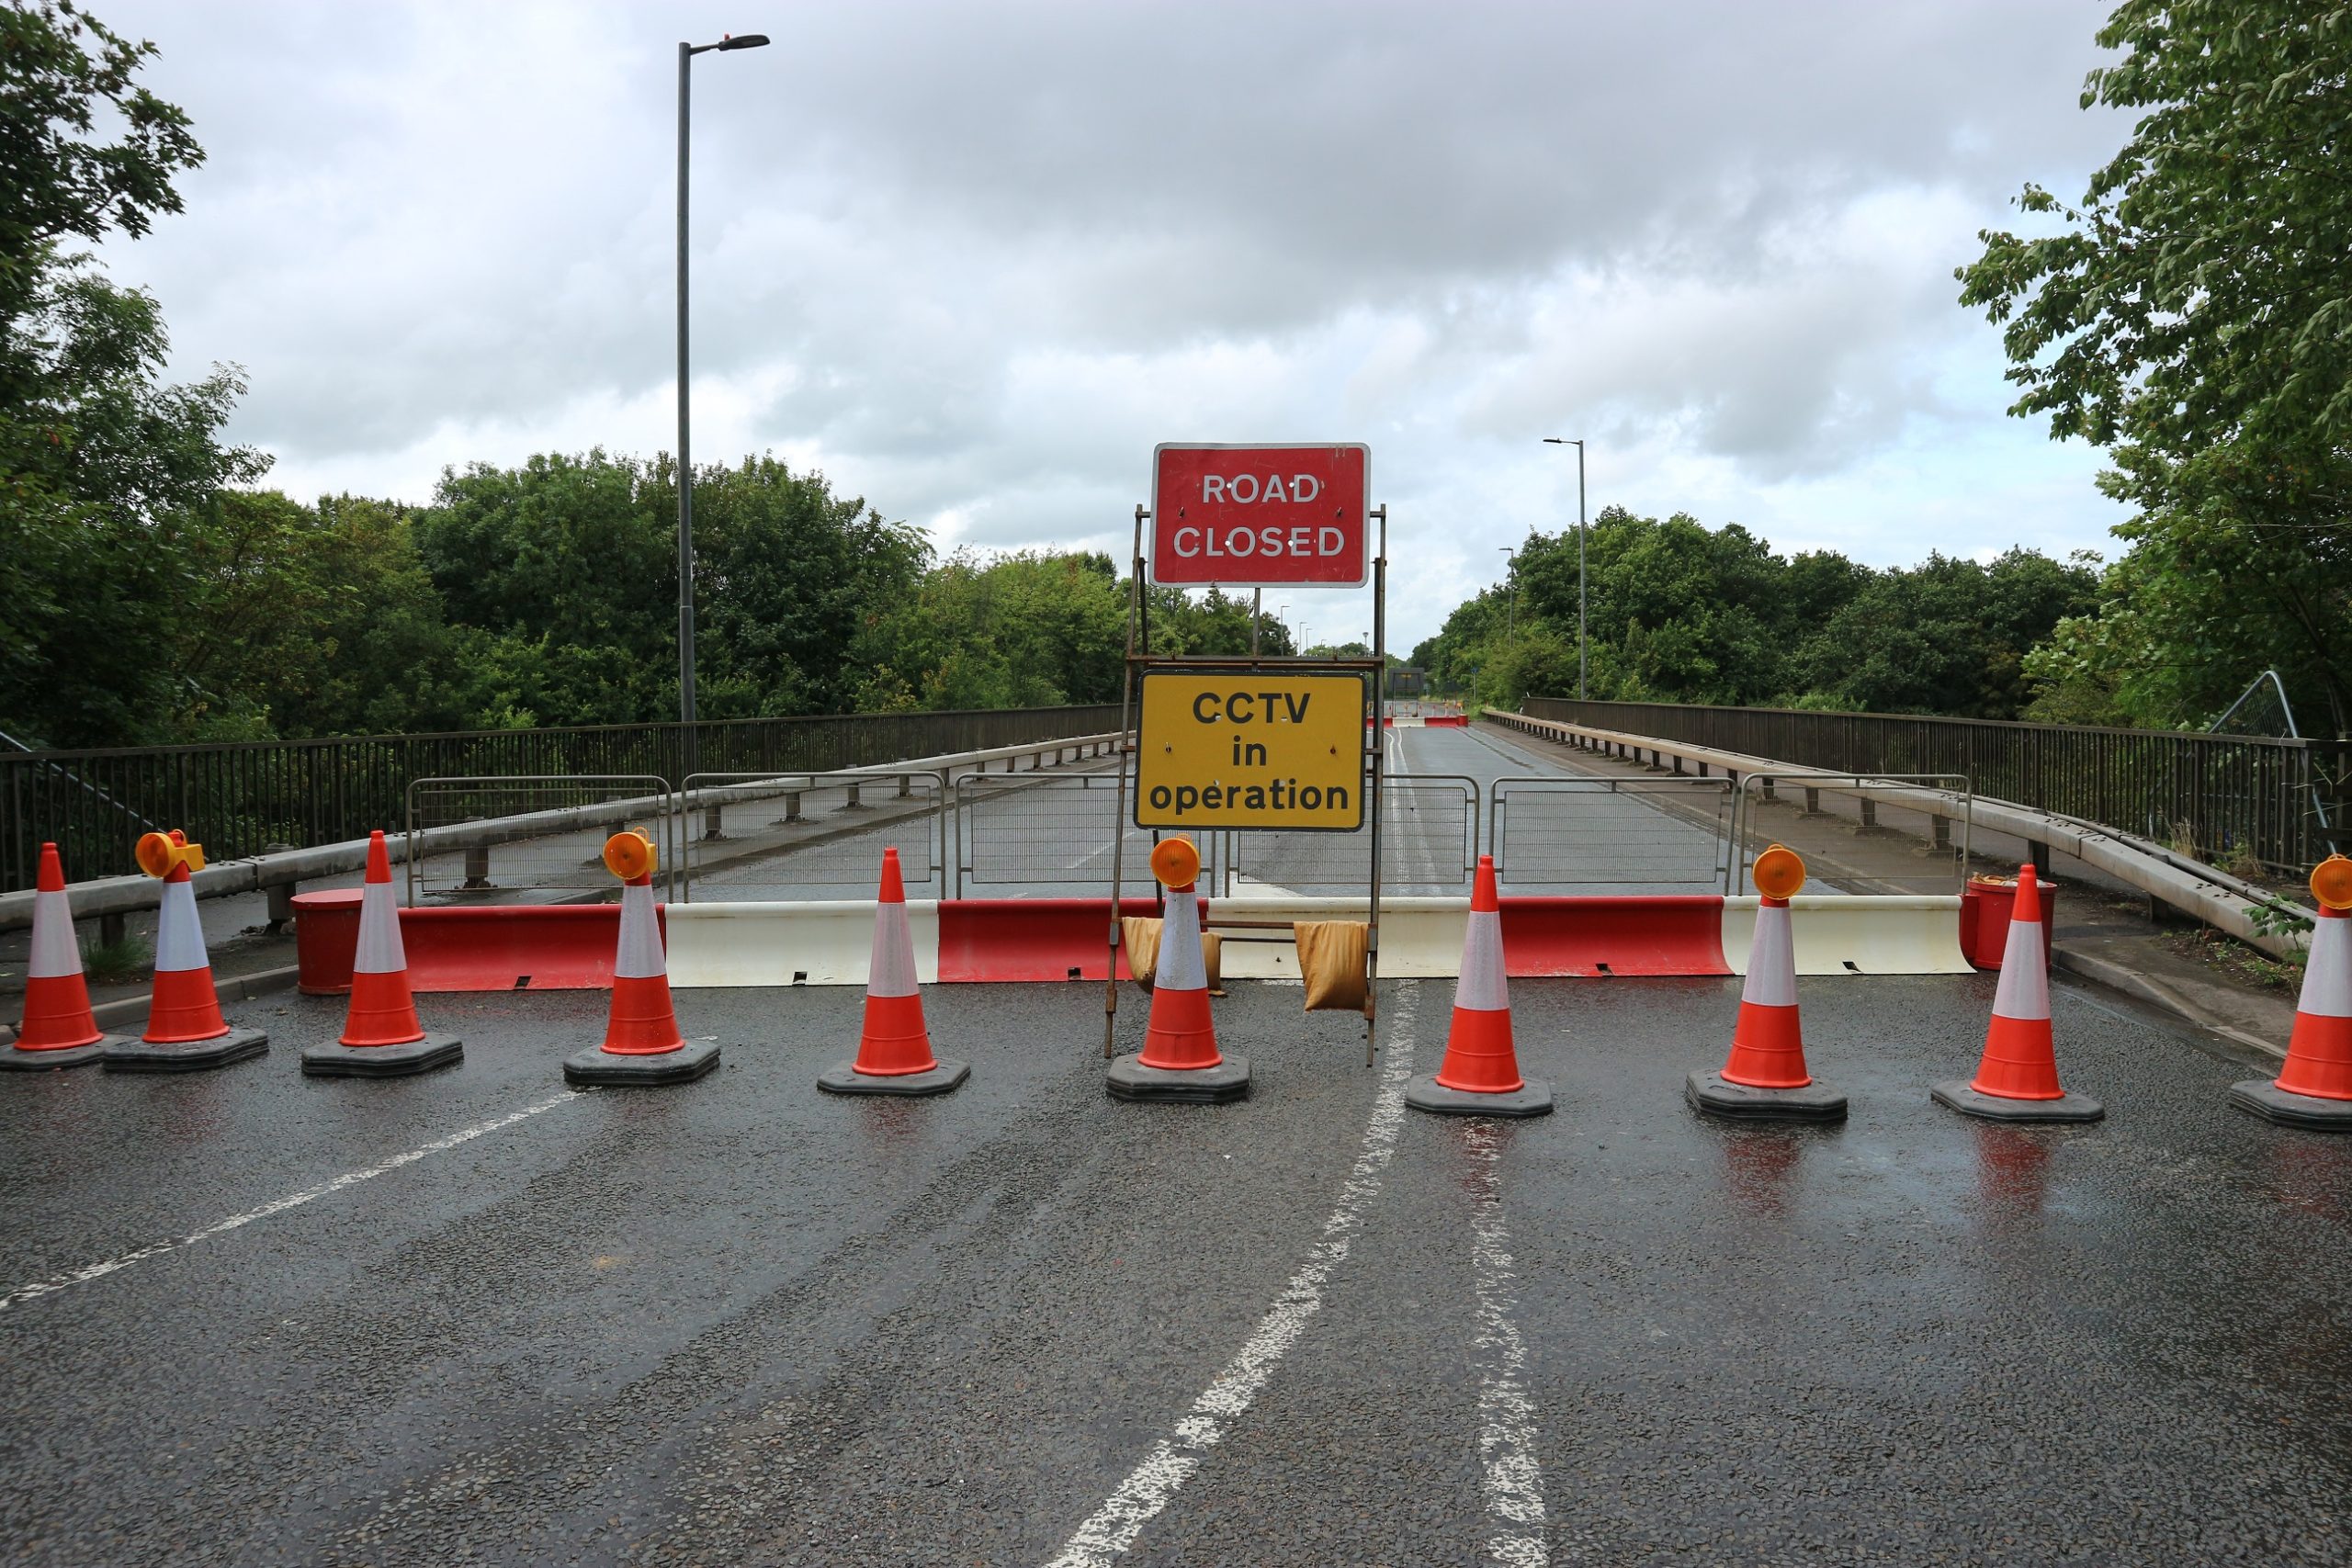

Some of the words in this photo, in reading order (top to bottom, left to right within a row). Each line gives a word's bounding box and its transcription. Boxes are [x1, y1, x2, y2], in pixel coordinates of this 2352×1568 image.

[1204, 475, 1318, 502] ROAD
[1174, 527, 1344, 557] CLOSED
[1193, 693, 1310, 724] CCTV
[1233, 735, 1266, 765] in
[1150, 778, 1348, 815] operation
